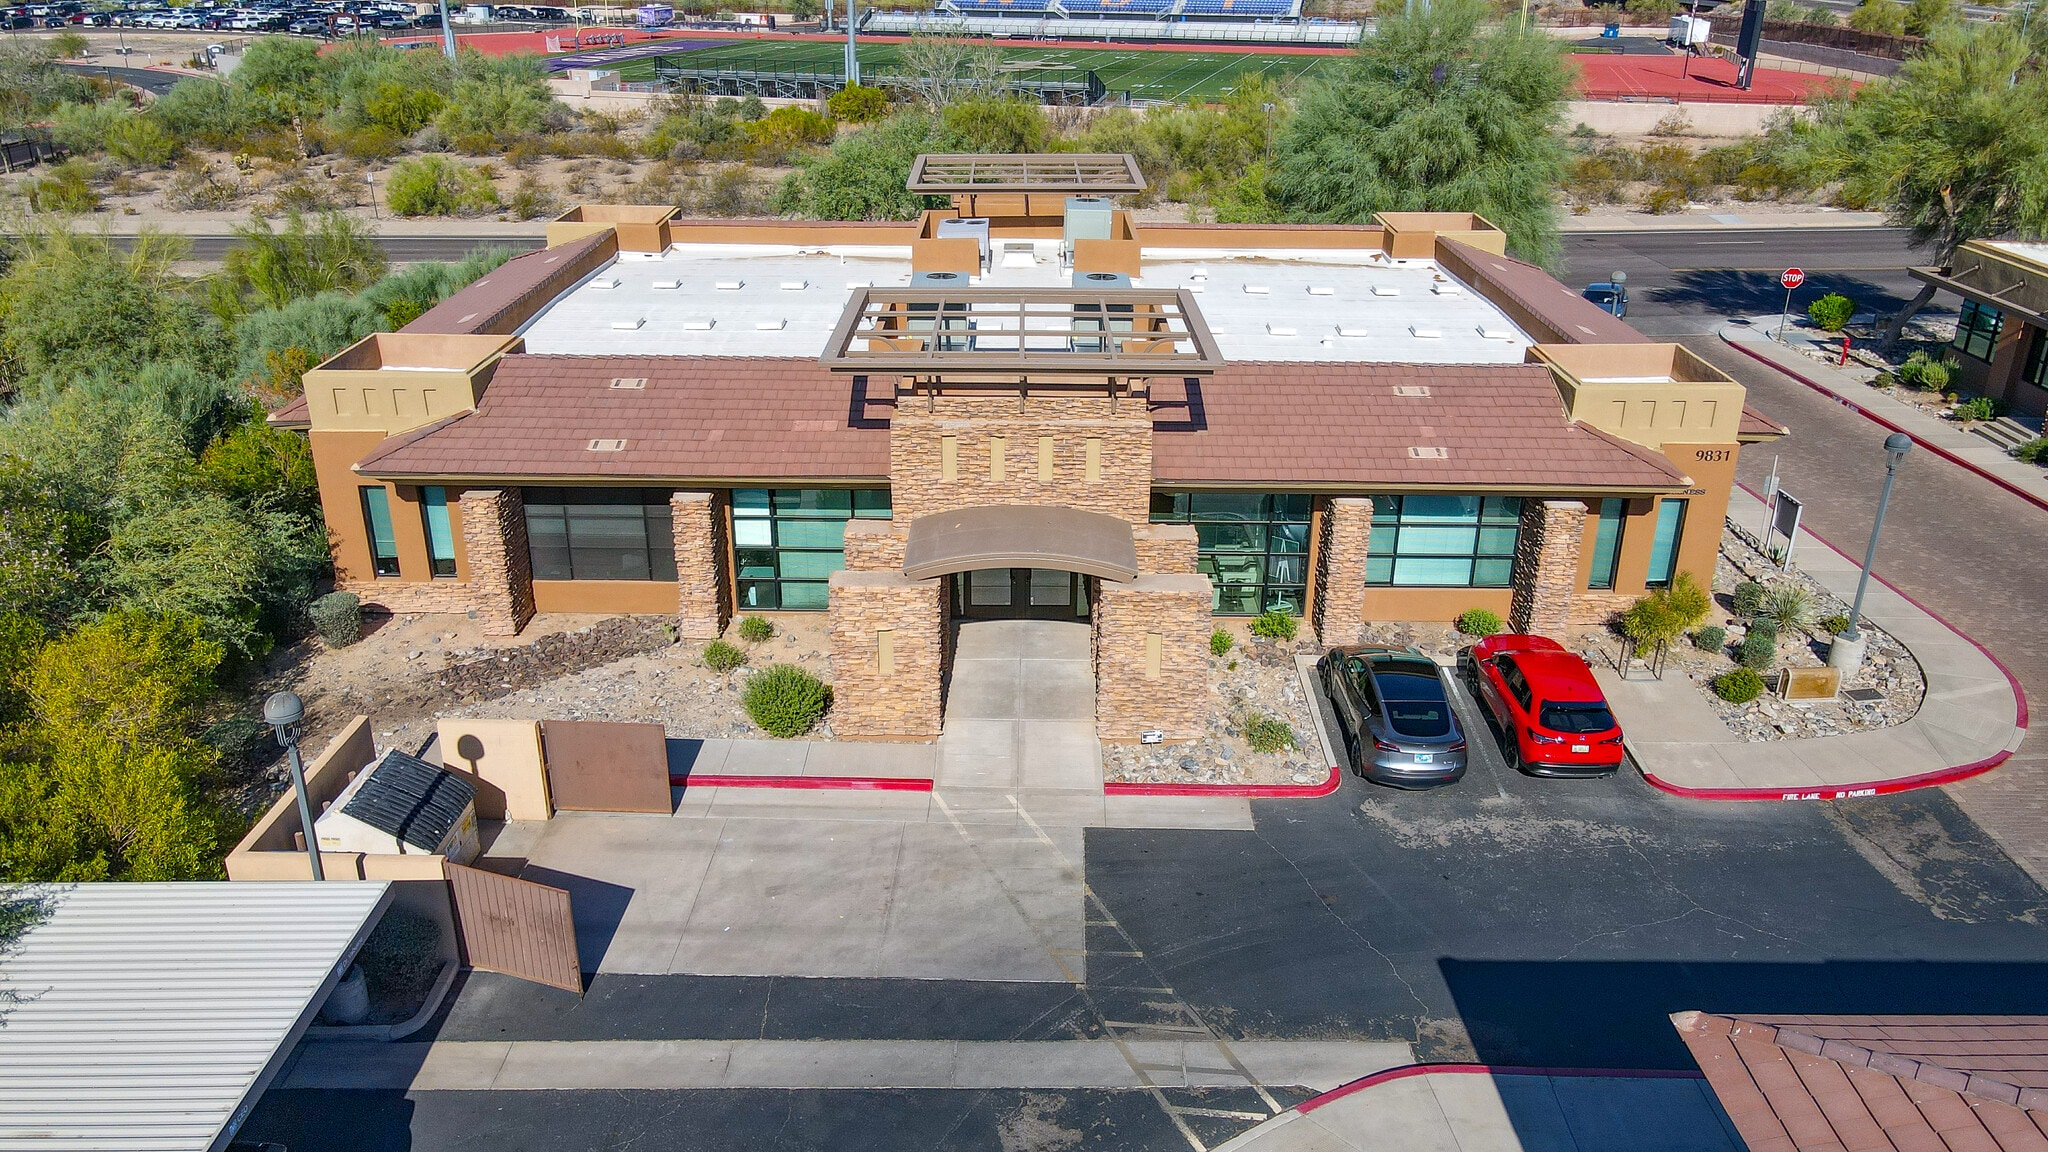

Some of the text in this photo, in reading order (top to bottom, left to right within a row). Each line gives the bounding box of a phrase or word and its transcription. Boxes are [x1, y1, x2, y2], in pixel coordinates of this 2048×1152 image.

[1783, 274, 1802, 283] STOP
[1696, 450, 1730, 461] 9831
[1782, 793, 1799, 801] FIRE
[1836, 791, 1846, 799] NO
[1848, 788, 1876, 798] PARKING
